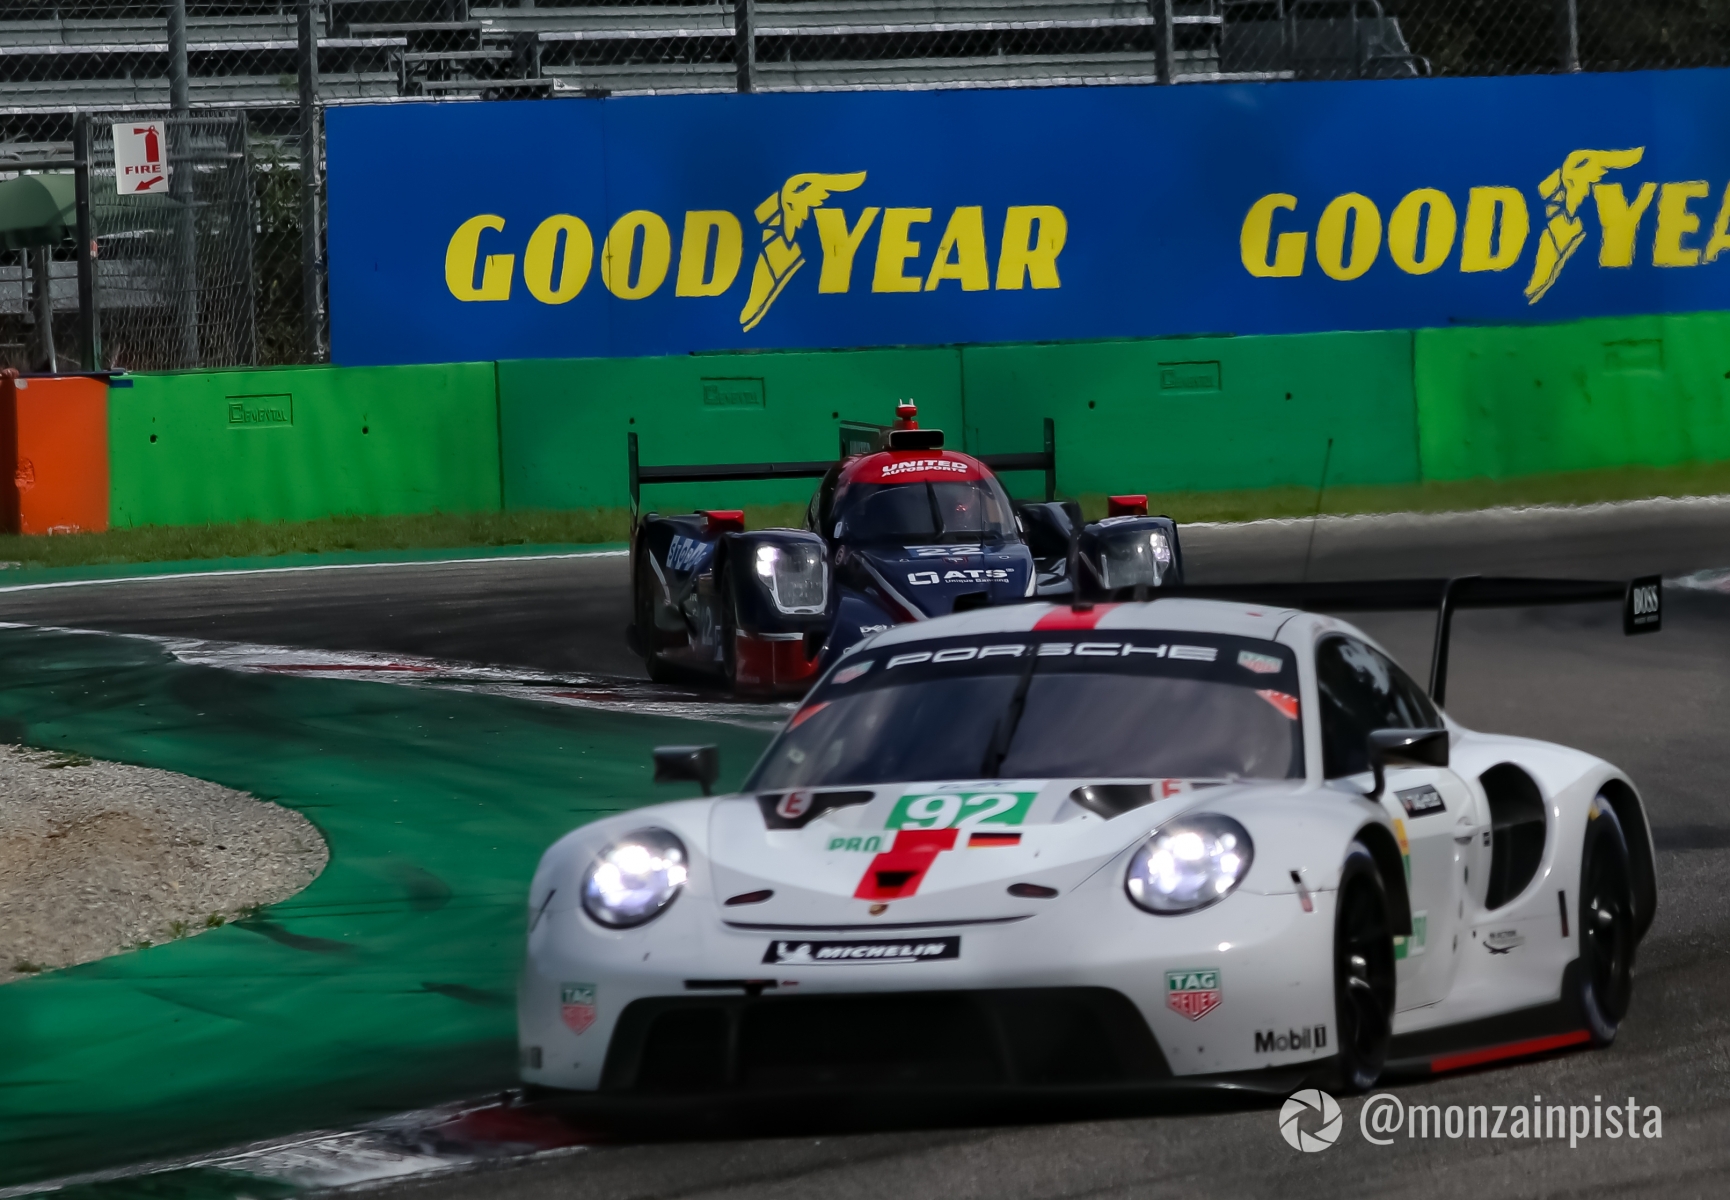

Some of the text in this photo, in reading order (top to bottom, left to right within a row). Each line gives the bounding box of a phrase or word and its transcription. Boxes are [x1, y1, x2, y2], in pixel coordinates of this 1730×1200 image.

[125, 164, 162, 175] FIRE
[881, 465, 967, 478] AUTOSPORTS
[882, 459, 968, 473] UNITED
[916, 545, 984, 557] 22
[943, 569, 1008, 579] ATS
[886, 642, 1218, 670] PORSCHE
[901, 793, 1019, 831] 92
[816, 942, 947, 960] MICHELIN
[1171, 974, 1216, 989] TAG
[1255, 1027, 1311, 1053] Mobil
